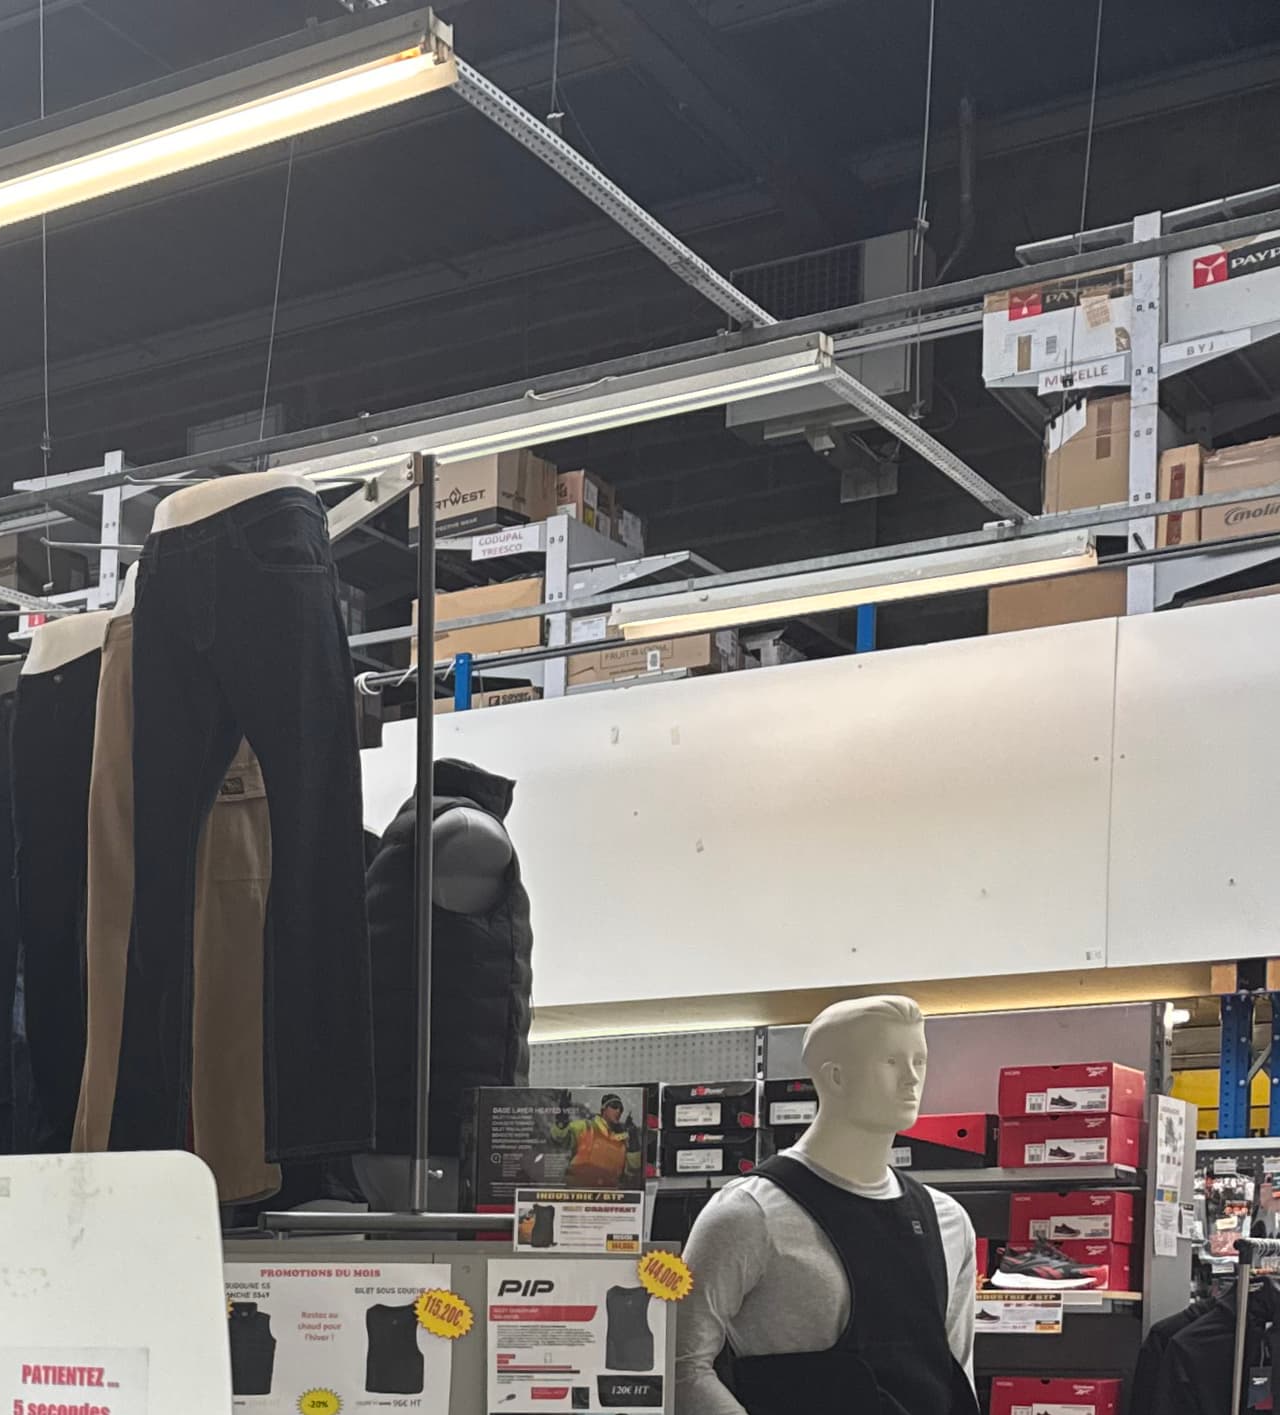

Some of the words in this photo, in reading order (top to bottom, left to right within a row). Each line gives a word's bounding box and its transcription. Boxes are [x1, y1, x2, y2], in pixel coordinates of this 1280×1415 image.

[260, 1268, 333, 1278] PROMOTIONS
[335, 1268, 351, 1278] DU
[353, 1268, 381, 1278] MOIS
[497, 1279, 555, 1298] PIP
[21, 1364, 105, 1388] PATIENTEZ
[611, 1384, 632, 1396] 120€
[634, 1384, 651, 1395] HT
[410, 1399, 422, 1408] HT
